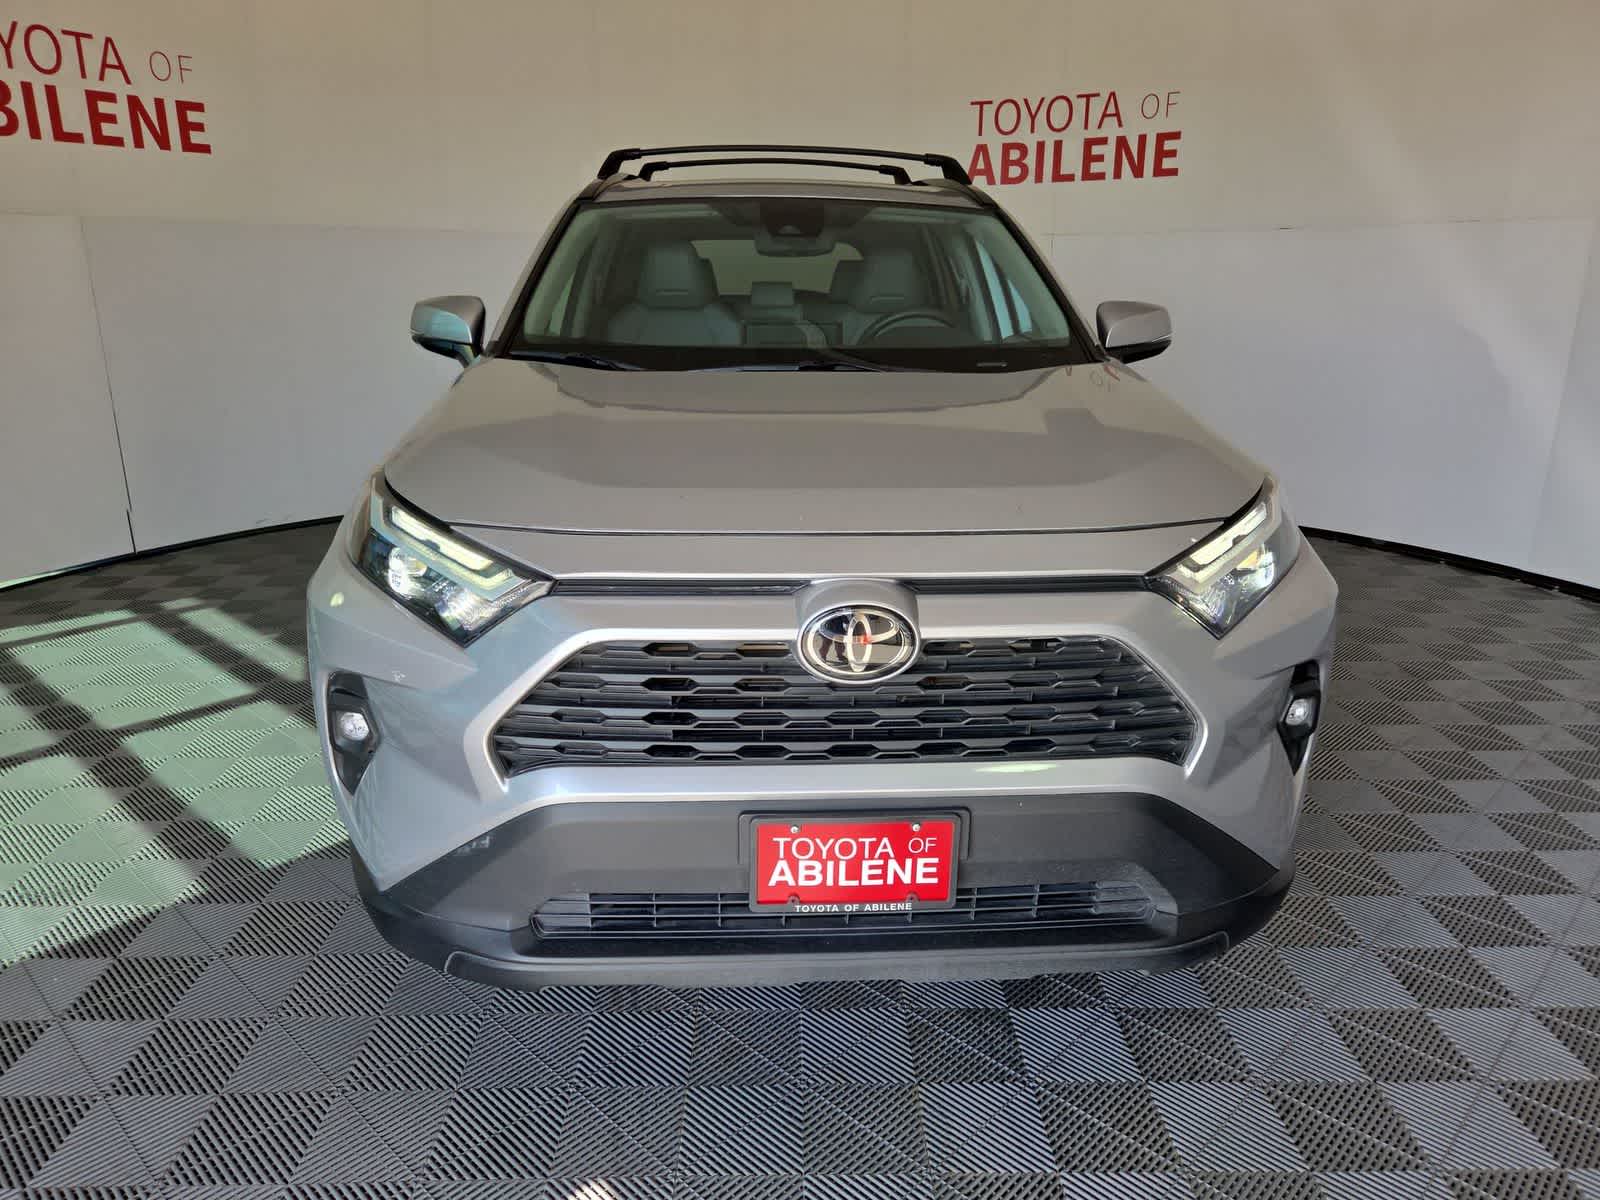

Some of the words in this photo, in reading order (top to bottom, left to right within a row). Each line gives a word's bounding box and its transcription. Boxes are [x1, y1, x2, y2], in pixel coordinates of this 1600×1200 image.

[149, 50, 193, 84] OF
[970, 91, 1123, 136] TOYOTA
[1141, 91, 1181, 119] OF
[967, 131, 1182, 185] ABILENE
[773, 837, 894, 860] TOYOTA
[908, 837, 937, 854] OF
[768, 857, 940, 887] ABILENE
[795, 904, 839, 913] TOYOTA
[844, 904, 859, 912] OF
[864, 902, 912, 911] ABILENE
